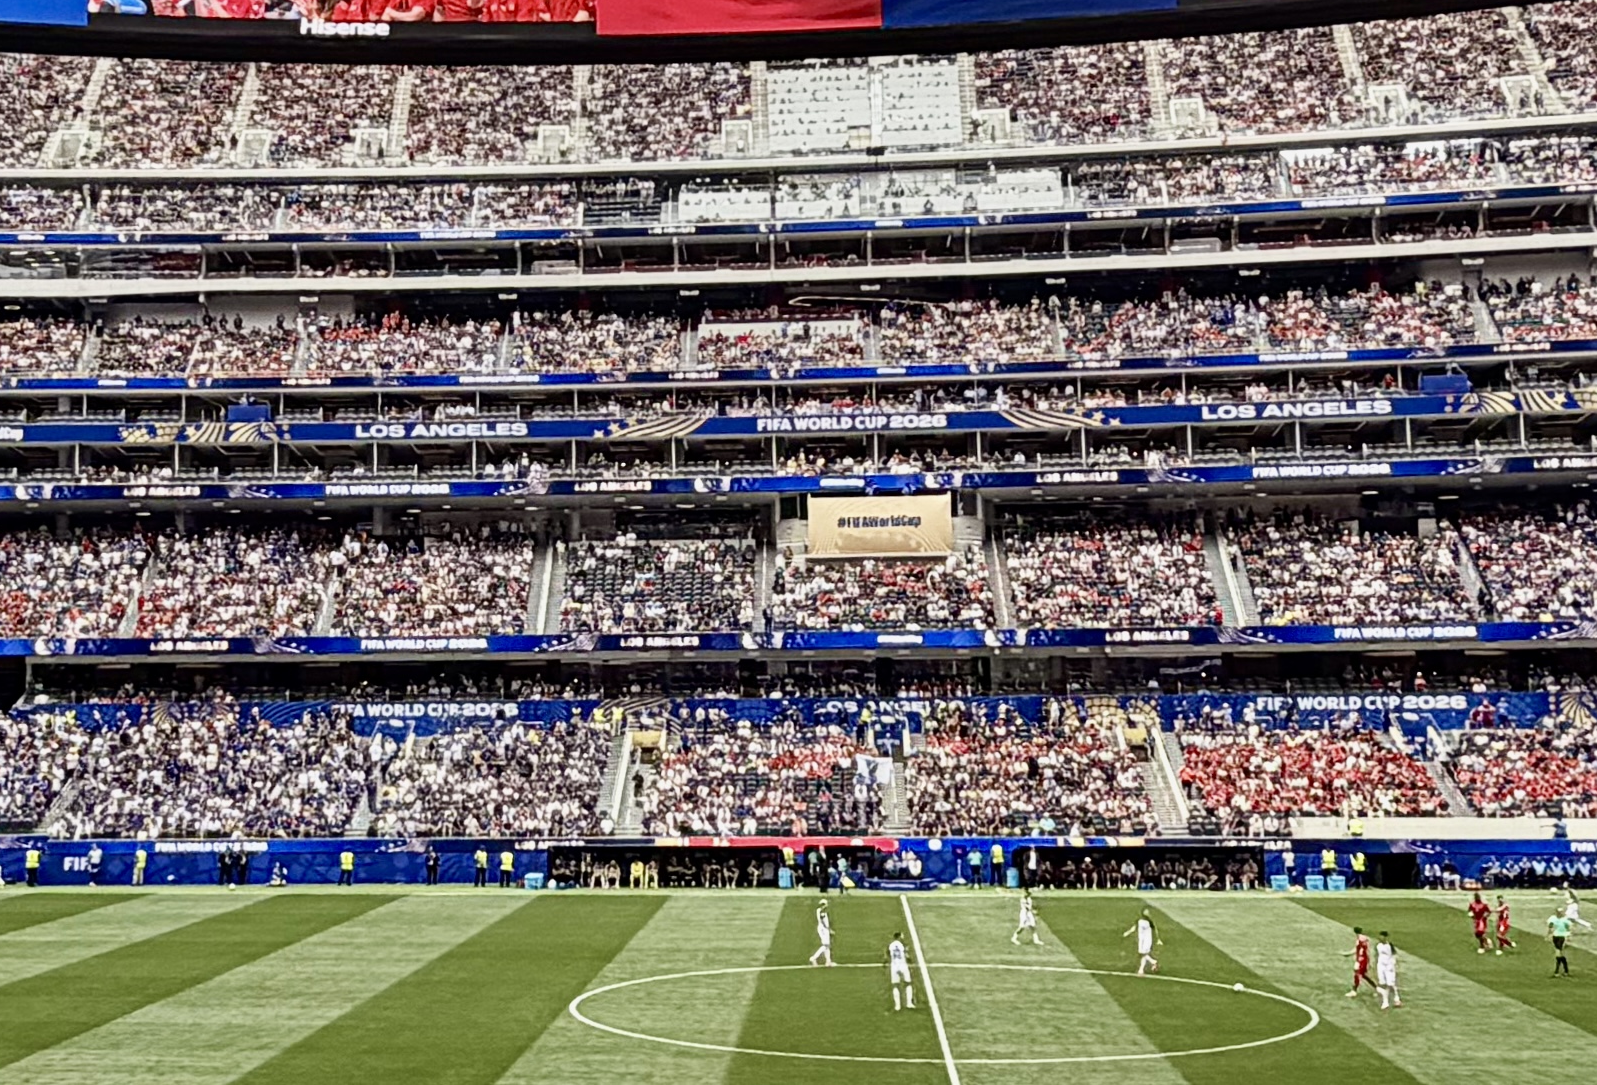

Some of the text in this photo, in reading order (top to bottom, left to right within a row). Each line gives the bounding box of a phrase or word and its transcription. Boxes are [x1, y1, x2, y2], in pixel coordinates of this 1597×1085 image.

[300, 16, 390, 36] Hisense
[1202, 400, 1392, 420] LOS ANGELES
[756, 414, 948, 431] FIFA WORLD CUP 2026
[355, 423, 529, 438] LOS ANGELES
[1334, 628, 1361, 639] FIFA
[1361, 627, 1406, 638] WORLD
[1406, 627, 1433, 638] CUP
[367, 703, 425, 717] WORLD
[1256, 697, 1292, 711] FIF
[1297, 696, 1362, 711] WORLD
[1403, 695, 1468, 710] 2026
[63, 856, 90, 871] FIF
